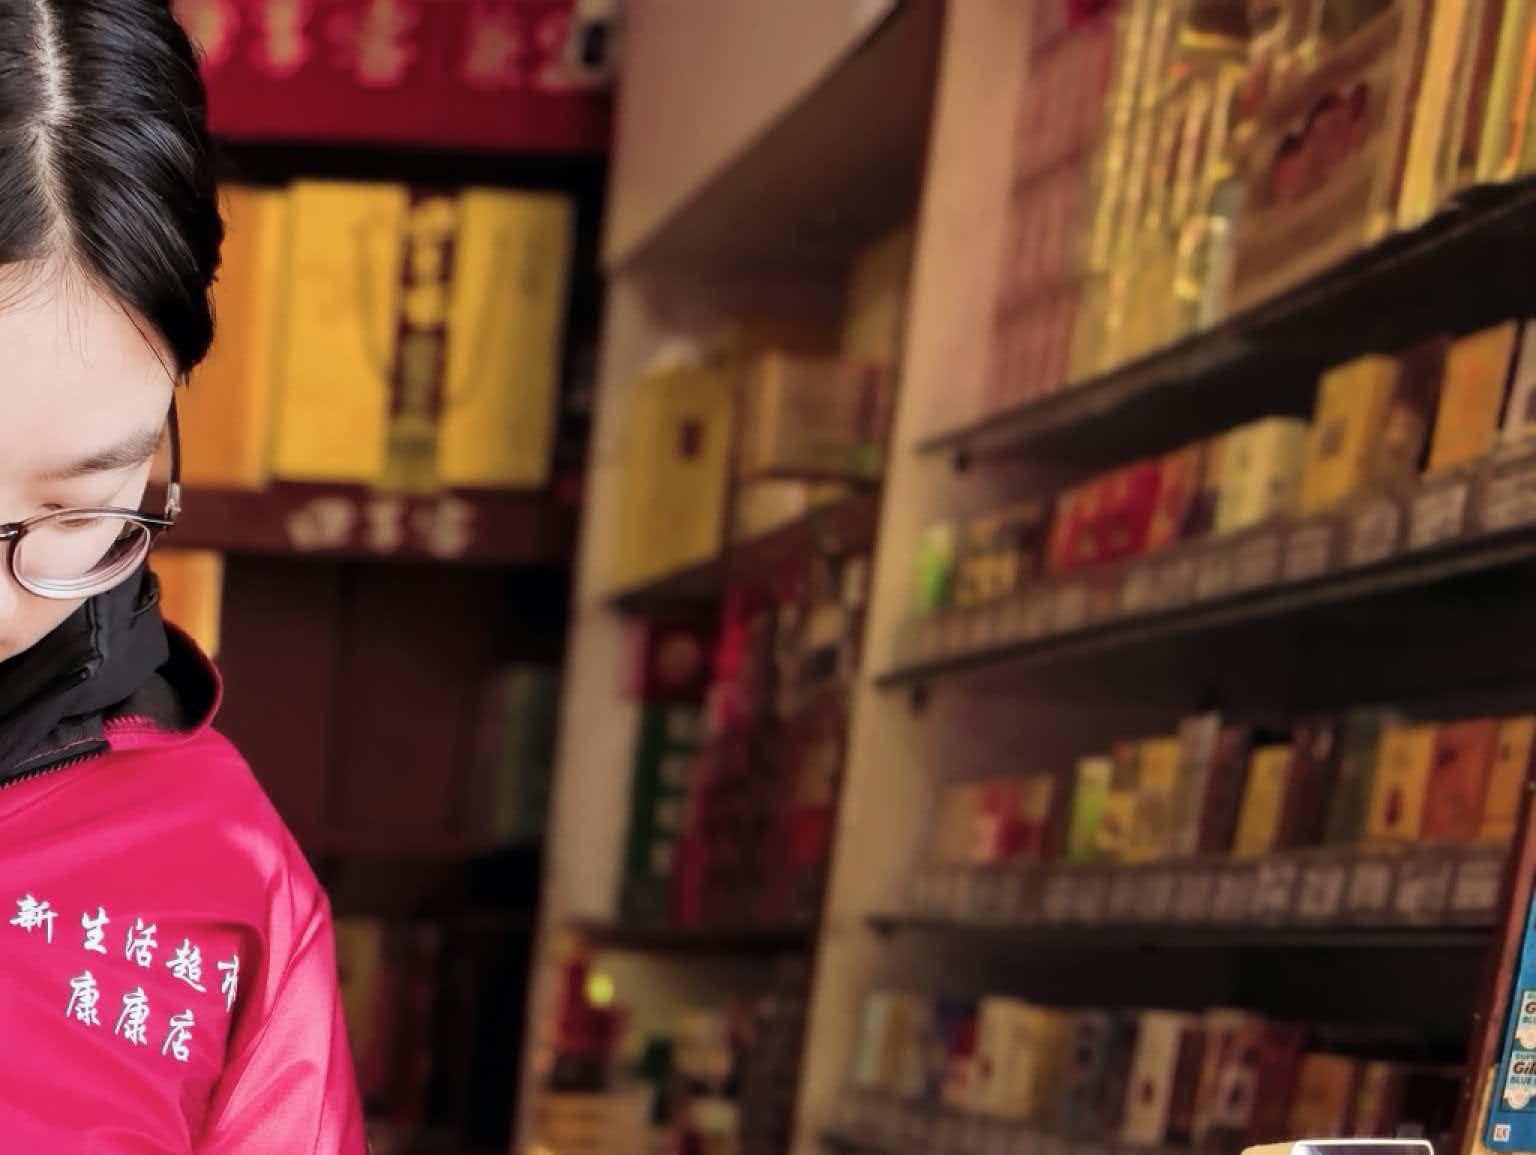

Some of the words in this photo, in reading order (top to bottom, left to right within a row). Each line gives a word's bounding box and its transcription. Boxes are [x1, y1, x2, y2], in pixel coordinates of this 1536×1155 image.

[9, 893, 240, 1013] 新生活超市
[66, 970, 195, 1062] 康康店
